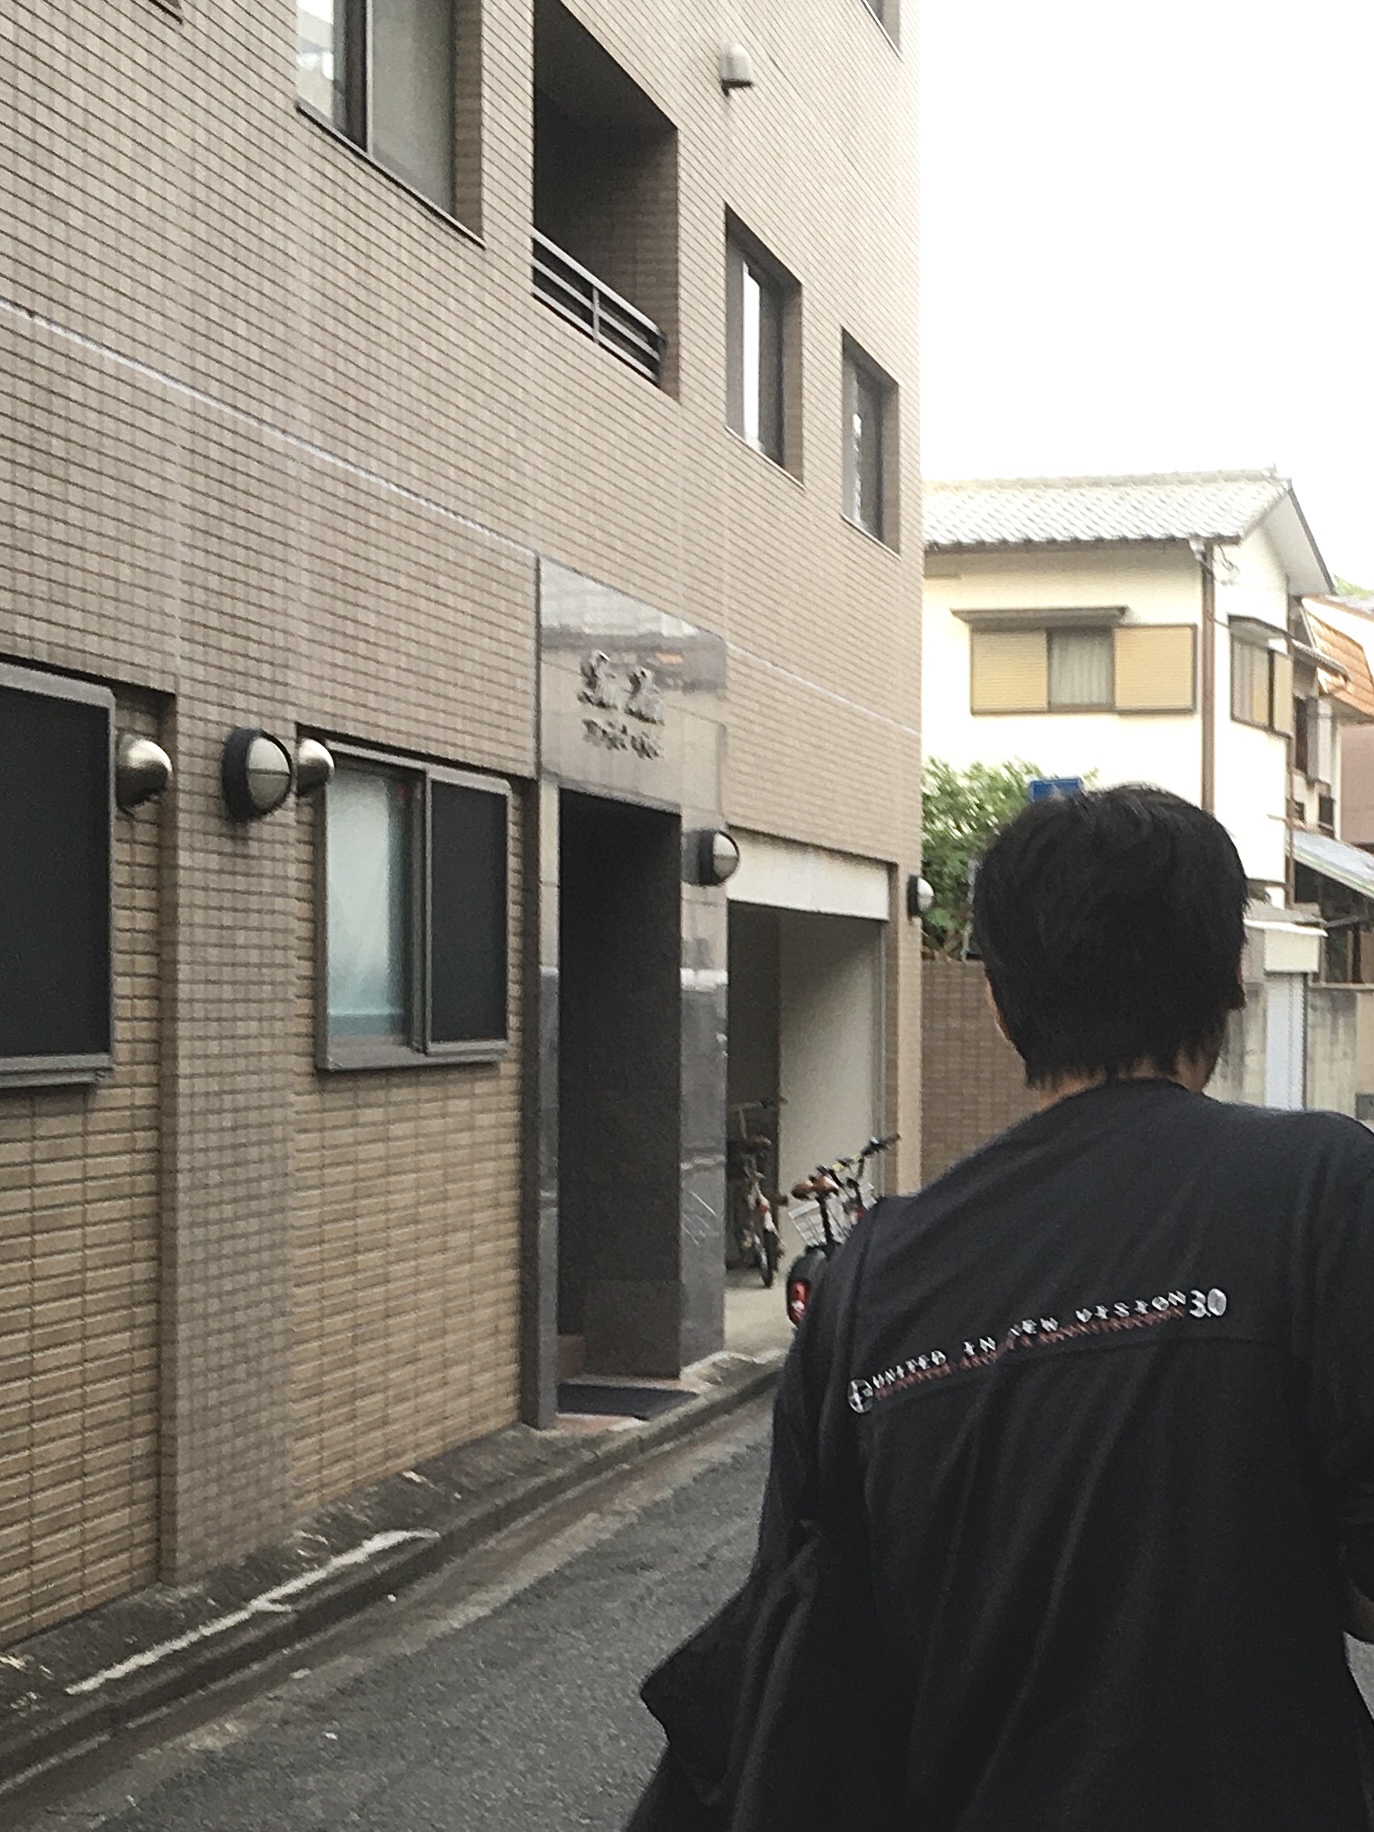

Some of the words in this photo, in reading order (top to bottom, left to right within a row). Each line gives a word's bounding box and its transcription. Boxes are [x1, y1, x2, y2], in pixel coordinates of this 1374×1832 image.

[872, 1350, 947, 1389] UNITED
[963, 1336, 996, 1356] IN
[1008, 1317, 1059, 1338] NEW
[1075, 1290, 1187, 1323] VISION
